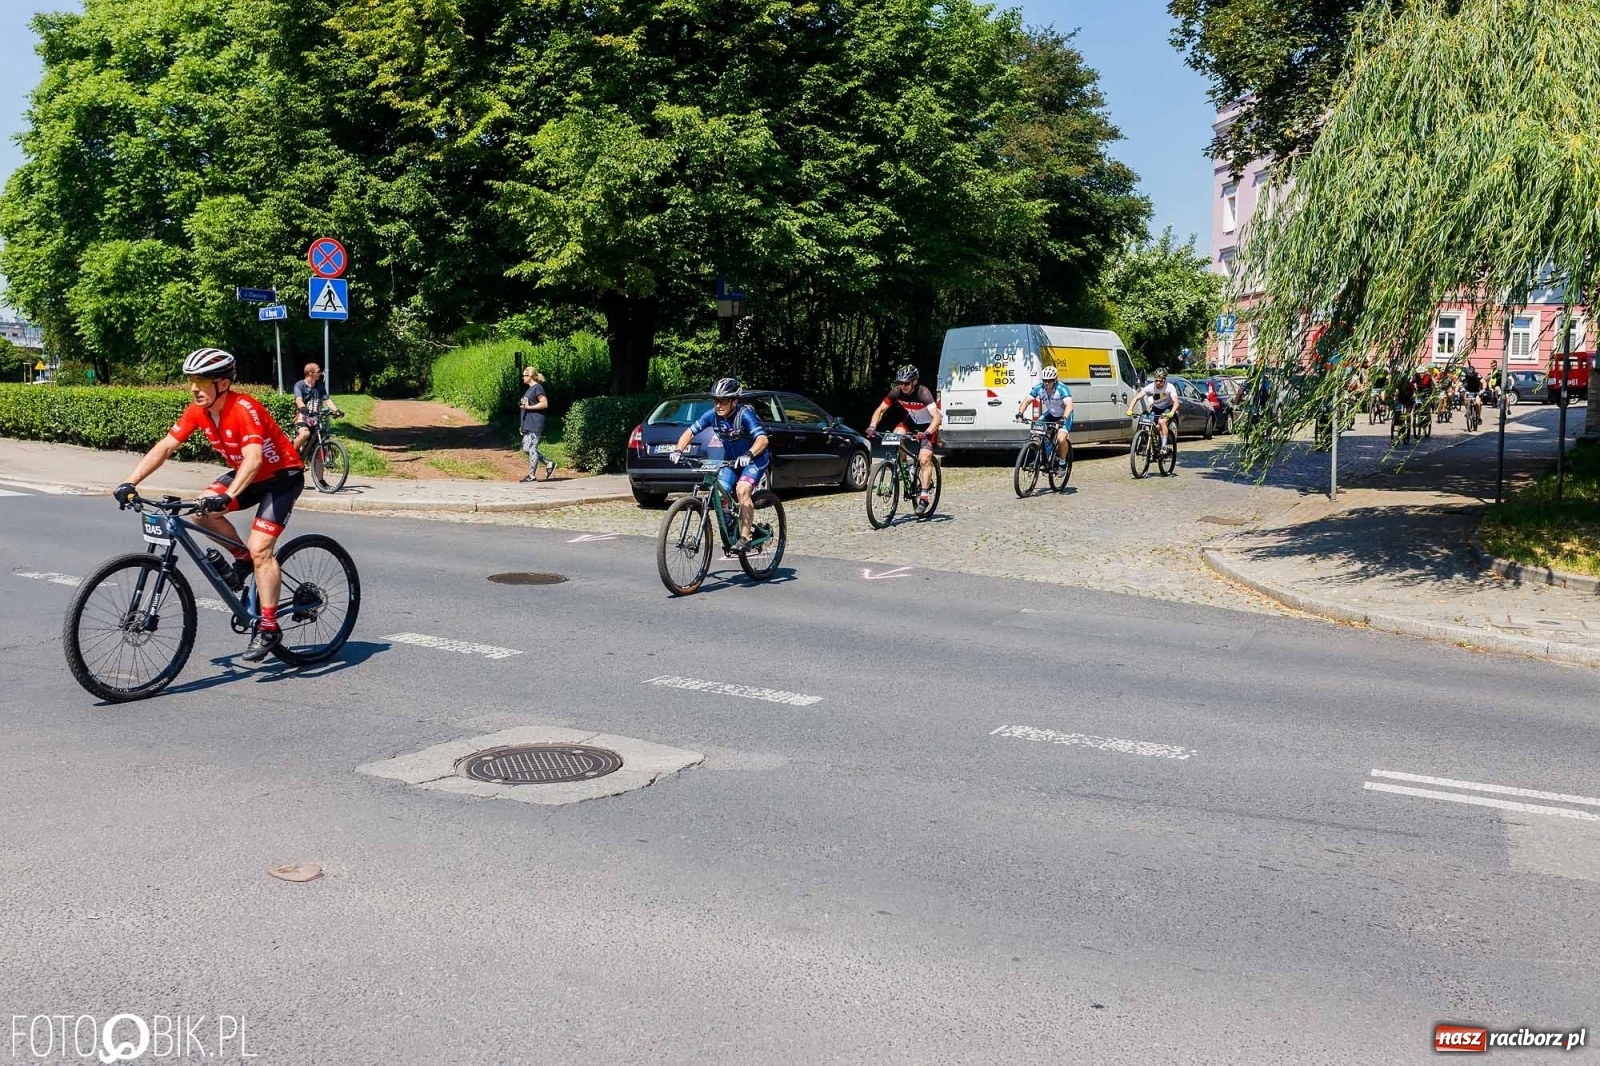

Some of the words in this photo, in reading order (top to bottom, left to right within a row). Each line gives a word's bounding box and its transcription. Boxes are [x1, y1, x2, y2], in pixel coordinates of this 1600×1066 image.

[959, 364, 981, 373] InPost
[261, 438, 280, 464] Nice
[144, 523, 163, 536] 1245
[255, 519, 275, 532] Nice
